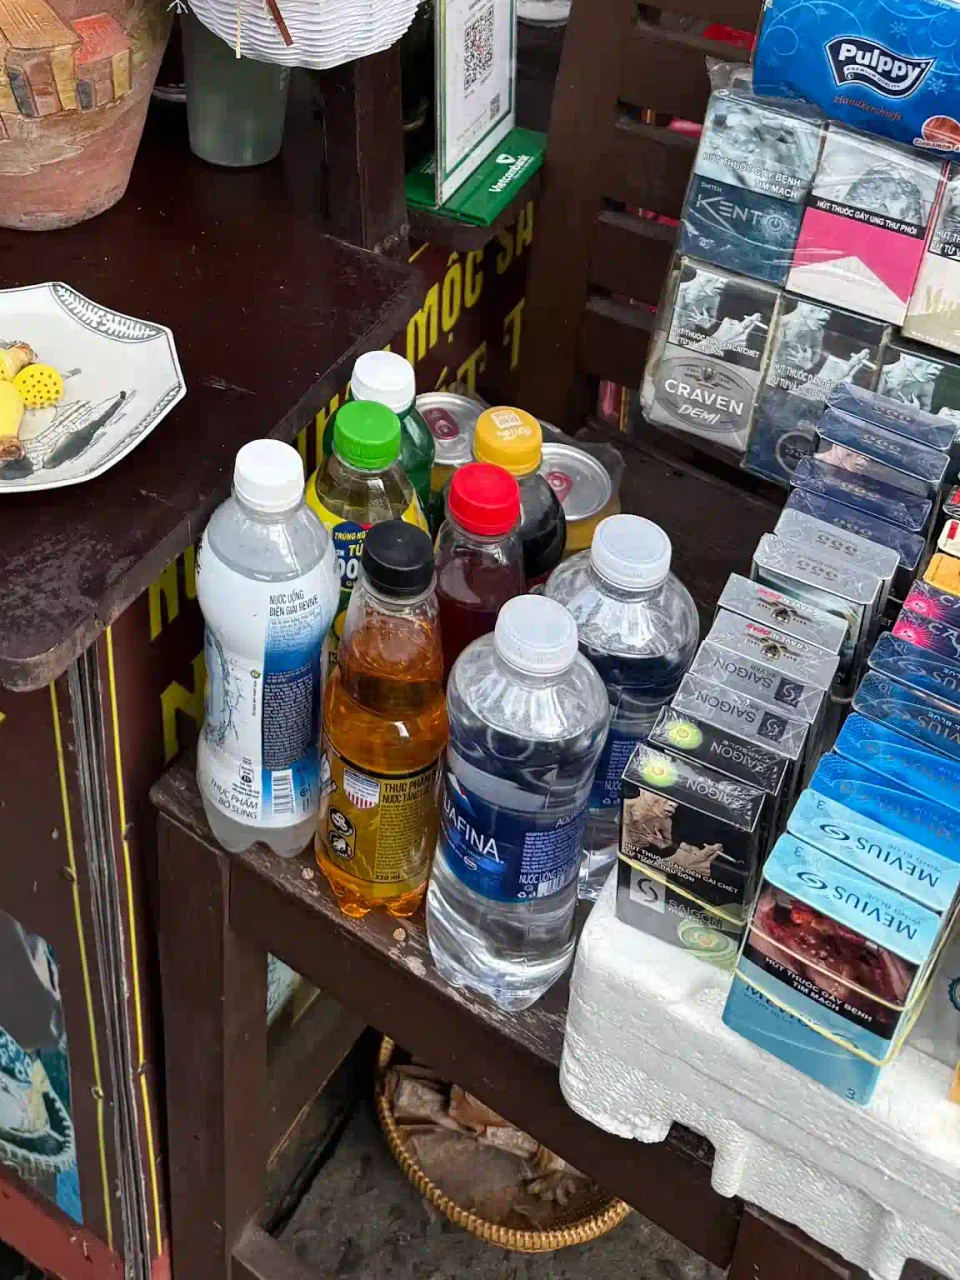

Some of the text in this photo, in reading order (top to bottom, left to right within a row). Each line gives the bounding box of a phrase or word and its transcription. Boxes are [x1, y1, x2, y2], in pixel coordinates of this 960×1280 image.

[838, 42, 922, 82] Pulppy
[834, 94, 902, 121] Handkerchiefs
[696, 194, 764, 234] KENT
[816, 199, 831, 210] HÚT
[831, 202, 854, 217] THUỐC
[854, 209, 869, 221] GÂY
[664, 379, 744, 416] CRAVEN
[678, 404, 721, 425] DEMI
[713, 656, 774, 689] SAIGON
[695, 691, 757, 724] SAIGON
[710, 741, 765, 773] SAIGON
[210, 777, 230, 799] THỰC
[686, 778, 744, 810] SAIGON
[232, 806, 258, 821] SUNG
[856, 836, 940, 889] MEVIUS
[668, 899, 723, 929] SAIGON
[832, 884, 919, 941] MEVIUS
[765, 956, 873, 1023] HÚT THUỐC GÂY BỆNH
[792, 979, 840, 1012] TIM MẠCH
[845, 1087, 856, 1100] 3
